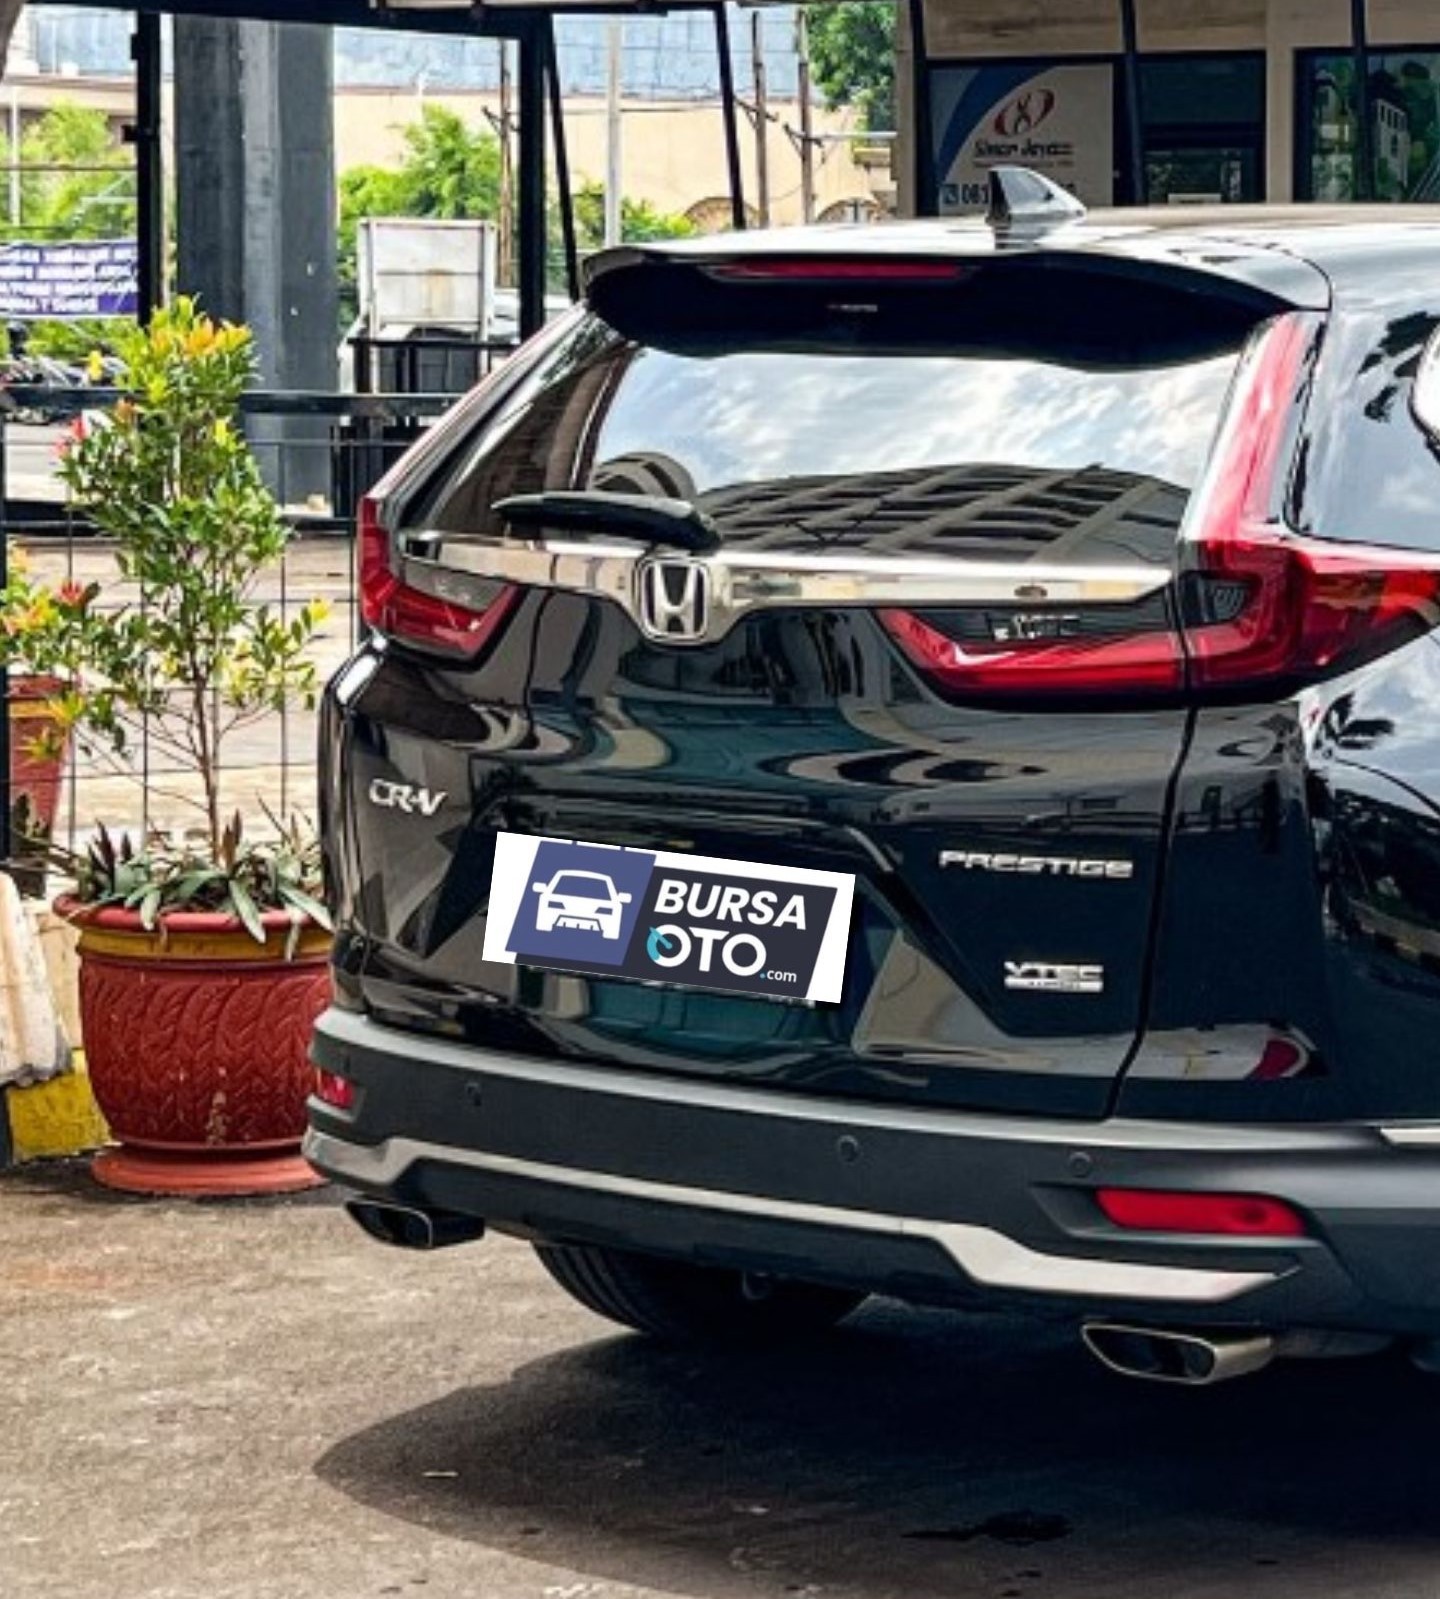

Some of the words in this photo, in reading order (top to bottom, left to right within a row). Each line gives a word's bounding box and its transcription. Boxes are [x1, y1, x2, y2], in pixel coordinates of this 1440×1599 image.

[369, 778, 448, 816] CR-V
[939, 850, 1133, 878] PRESTIGE
[1004, 961, 1104, 980] VTEC
